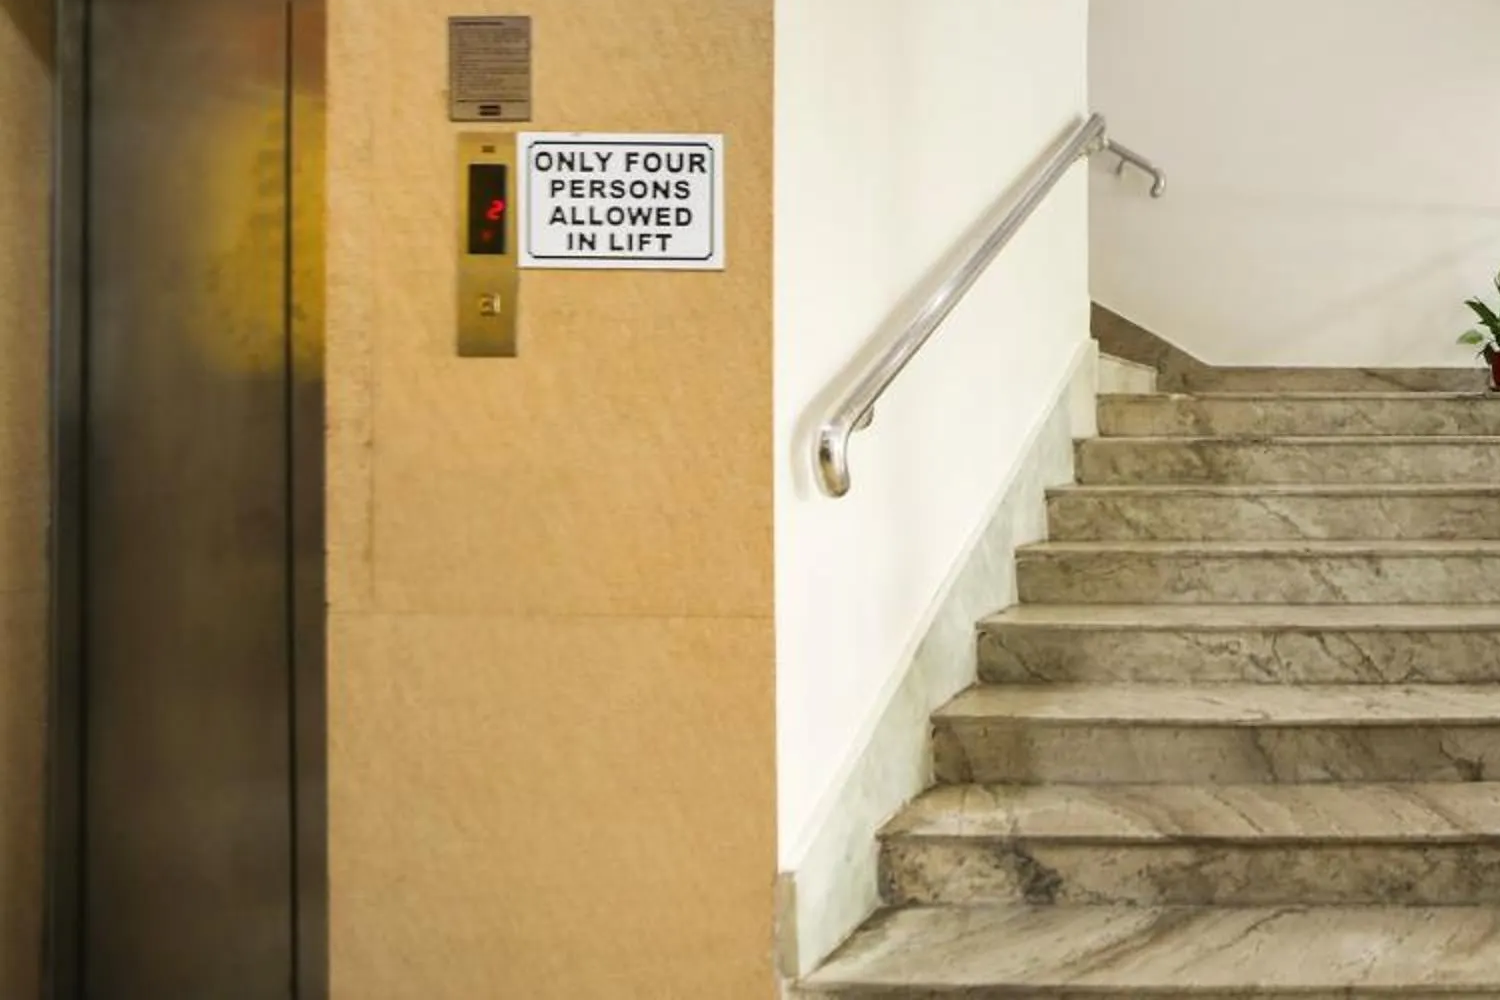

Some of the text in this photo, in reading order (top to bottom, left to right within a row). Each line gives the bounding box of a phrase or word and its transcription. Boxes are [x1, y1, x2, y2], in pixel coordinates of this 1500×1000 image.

[535, 152, 707, 174] ONLY FOUR
[551, 180, 691, 199] PERSONS
[549, 206, 693, 227] ALLOWED
[567, 233, 673, 252] IN LIFT
